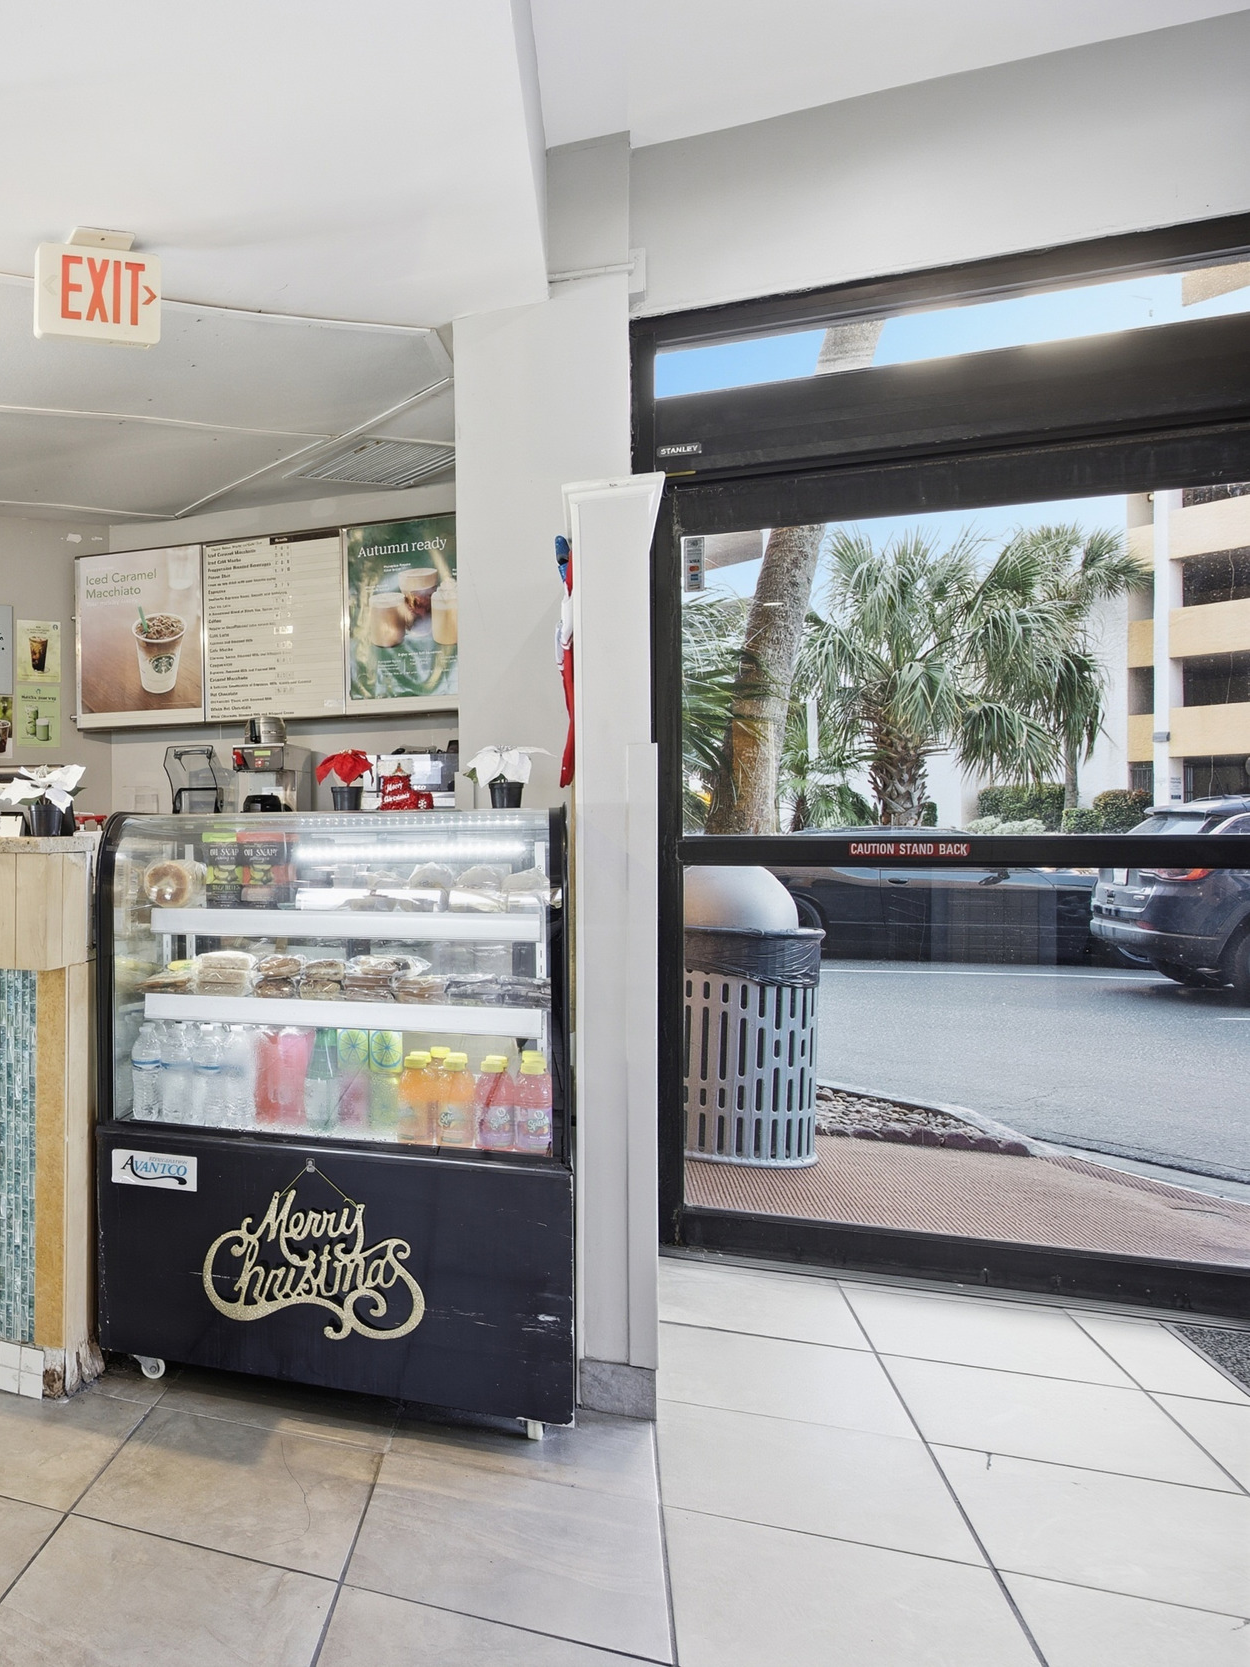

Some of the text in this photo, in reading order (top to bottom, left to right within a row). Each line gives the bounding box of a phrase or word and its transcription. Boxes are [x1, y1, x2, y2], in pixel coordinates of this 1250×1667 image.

[61, 255, 146, 326] EXIT
[660, 445, 698, 455] STANLEY
[357, 536, 447, 558] Autumn ready
[86, 569, 157, 585] Iced Caramel
[86, 587, 141, 599] Macchiato
[850, 843, 967, 856] CAUTION STAND BACK
[120, 1155, 187, 1180] AVANTCO
[241, 1190, 365, 1262] Merry
[203, 1239, 425, 1340] Christmas
